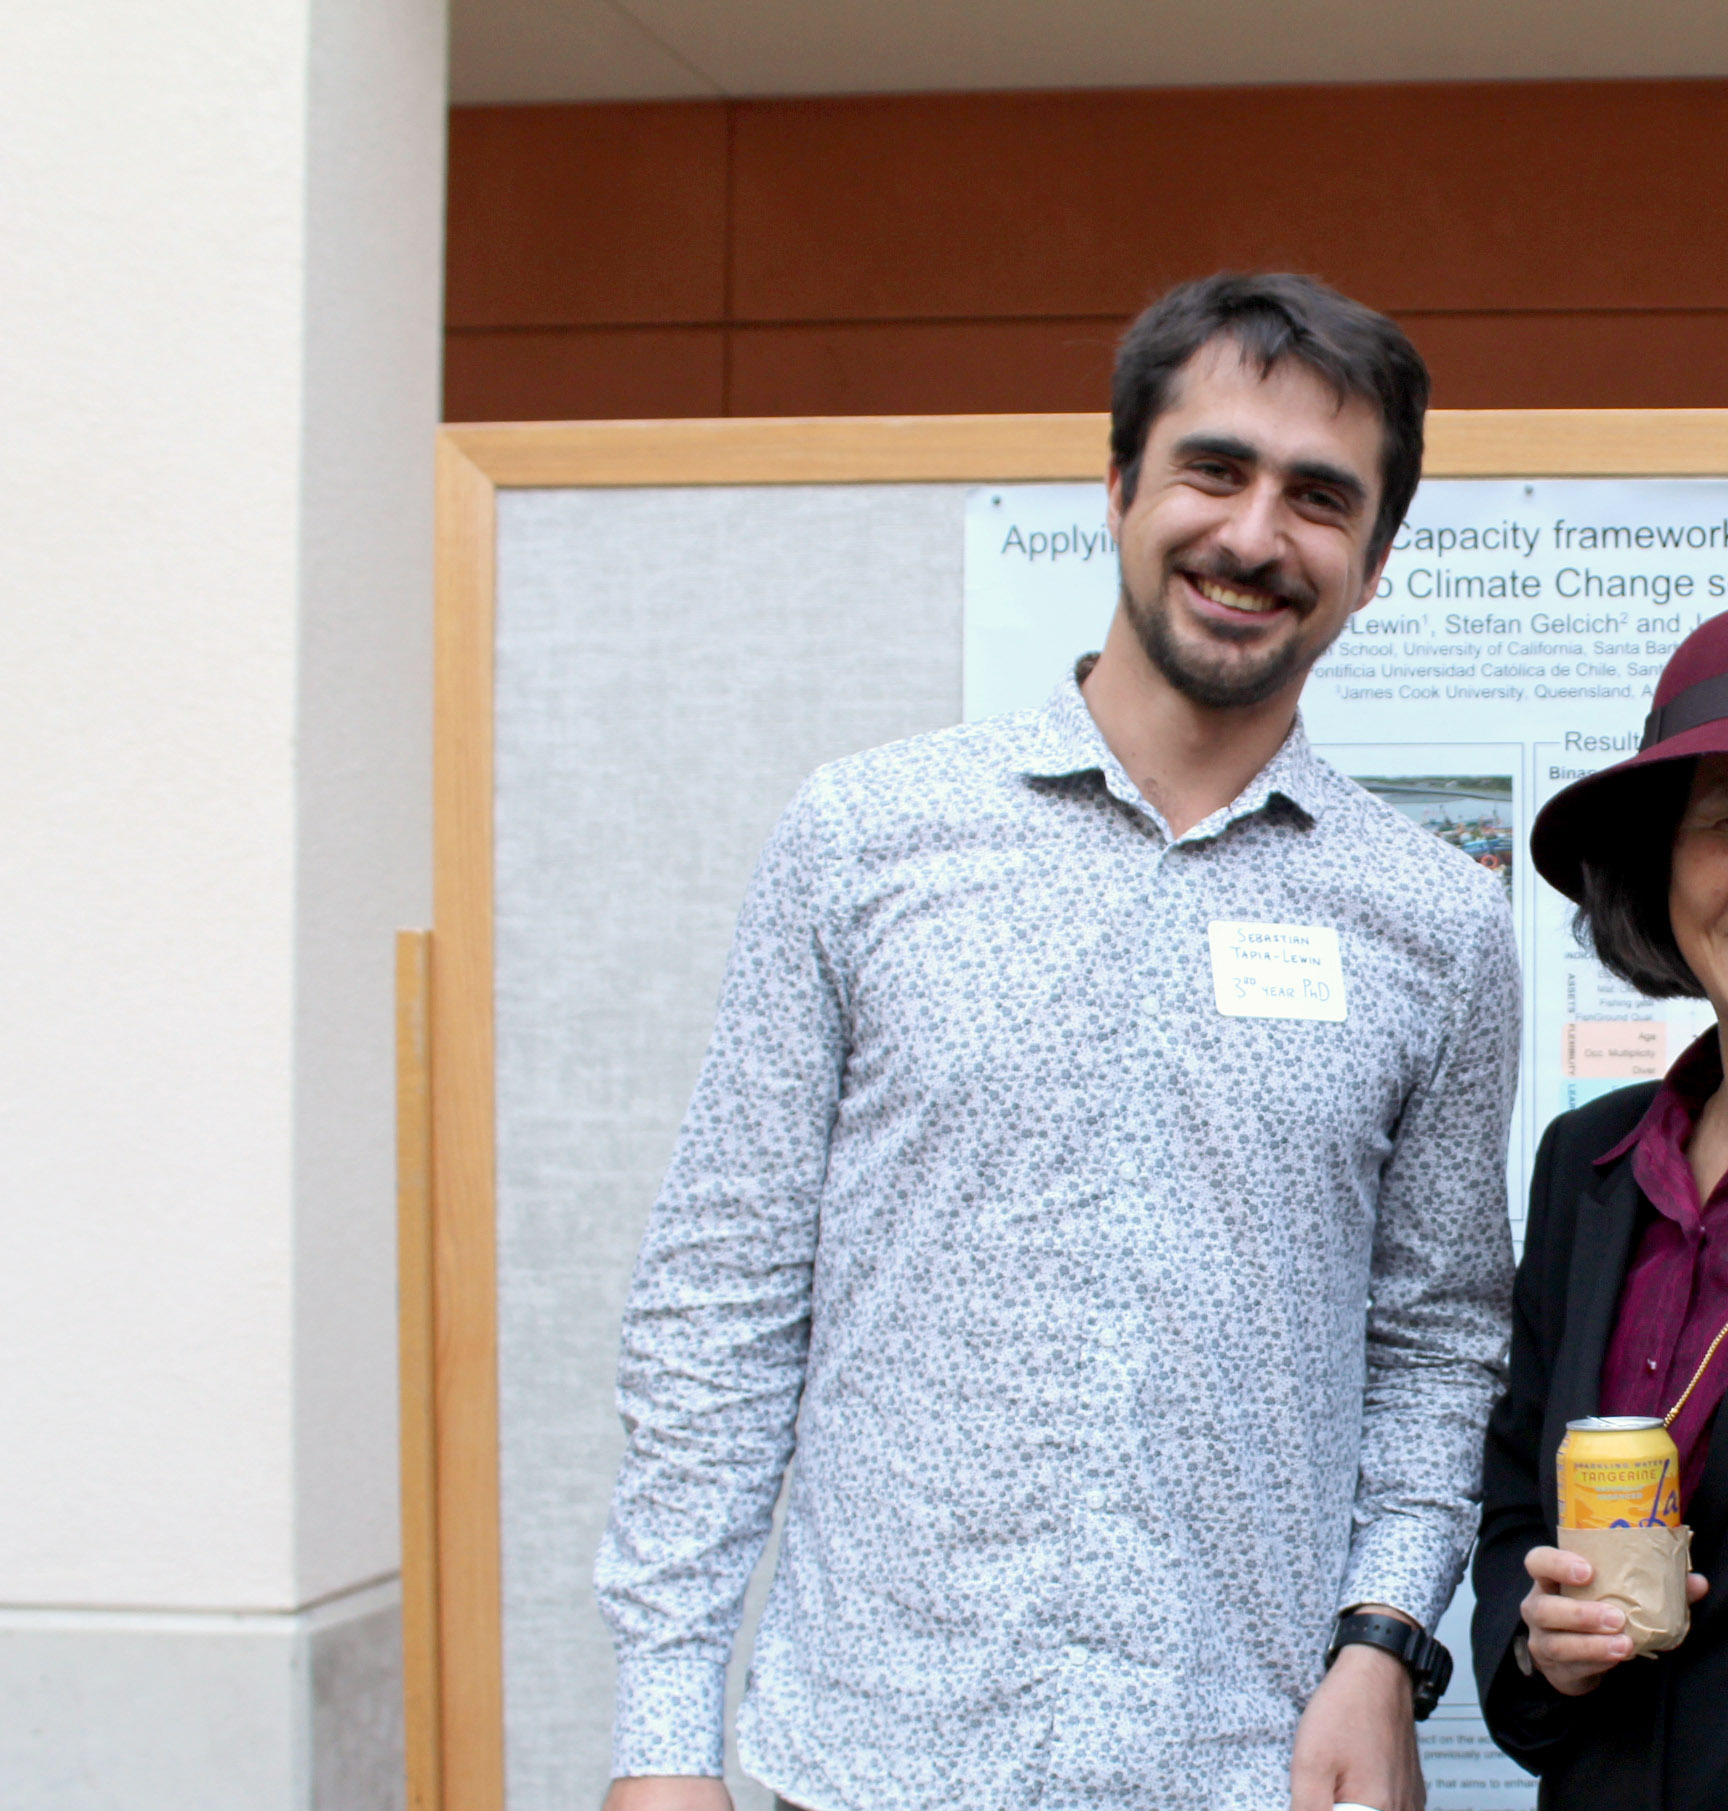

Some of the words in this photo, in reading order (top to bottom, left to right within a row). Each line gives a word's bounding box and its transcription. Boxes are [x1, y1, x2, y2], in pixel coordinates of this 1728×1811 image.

[1001, 524, 1115, 562] Applyi
[1392, 519, 1540, 557] Capacity
[1407, 567, 1542, 599] Climate
[1555, 566, 1694, 605] Change
[1445, 613, 1522, 635] Stefan
[1636, 612, 1681, 633] and
[1403, 641, 1482, 659] University
[1487, 641, 1504, 656] of
[1593, 640, 1640, 655] Santa
[1311, 663, 1376, 678] ontificia
[1381, 663, 1475, 678] Universidad
[1550, 662, 1571, 676] de
[1399, 684, 1440, 699] Cook
[1262, 985, 1295, 998] YEAR
[1638, 1032, 1656, 1043] Age
[1581, 1468, 1657, 1482] TANGERINE
